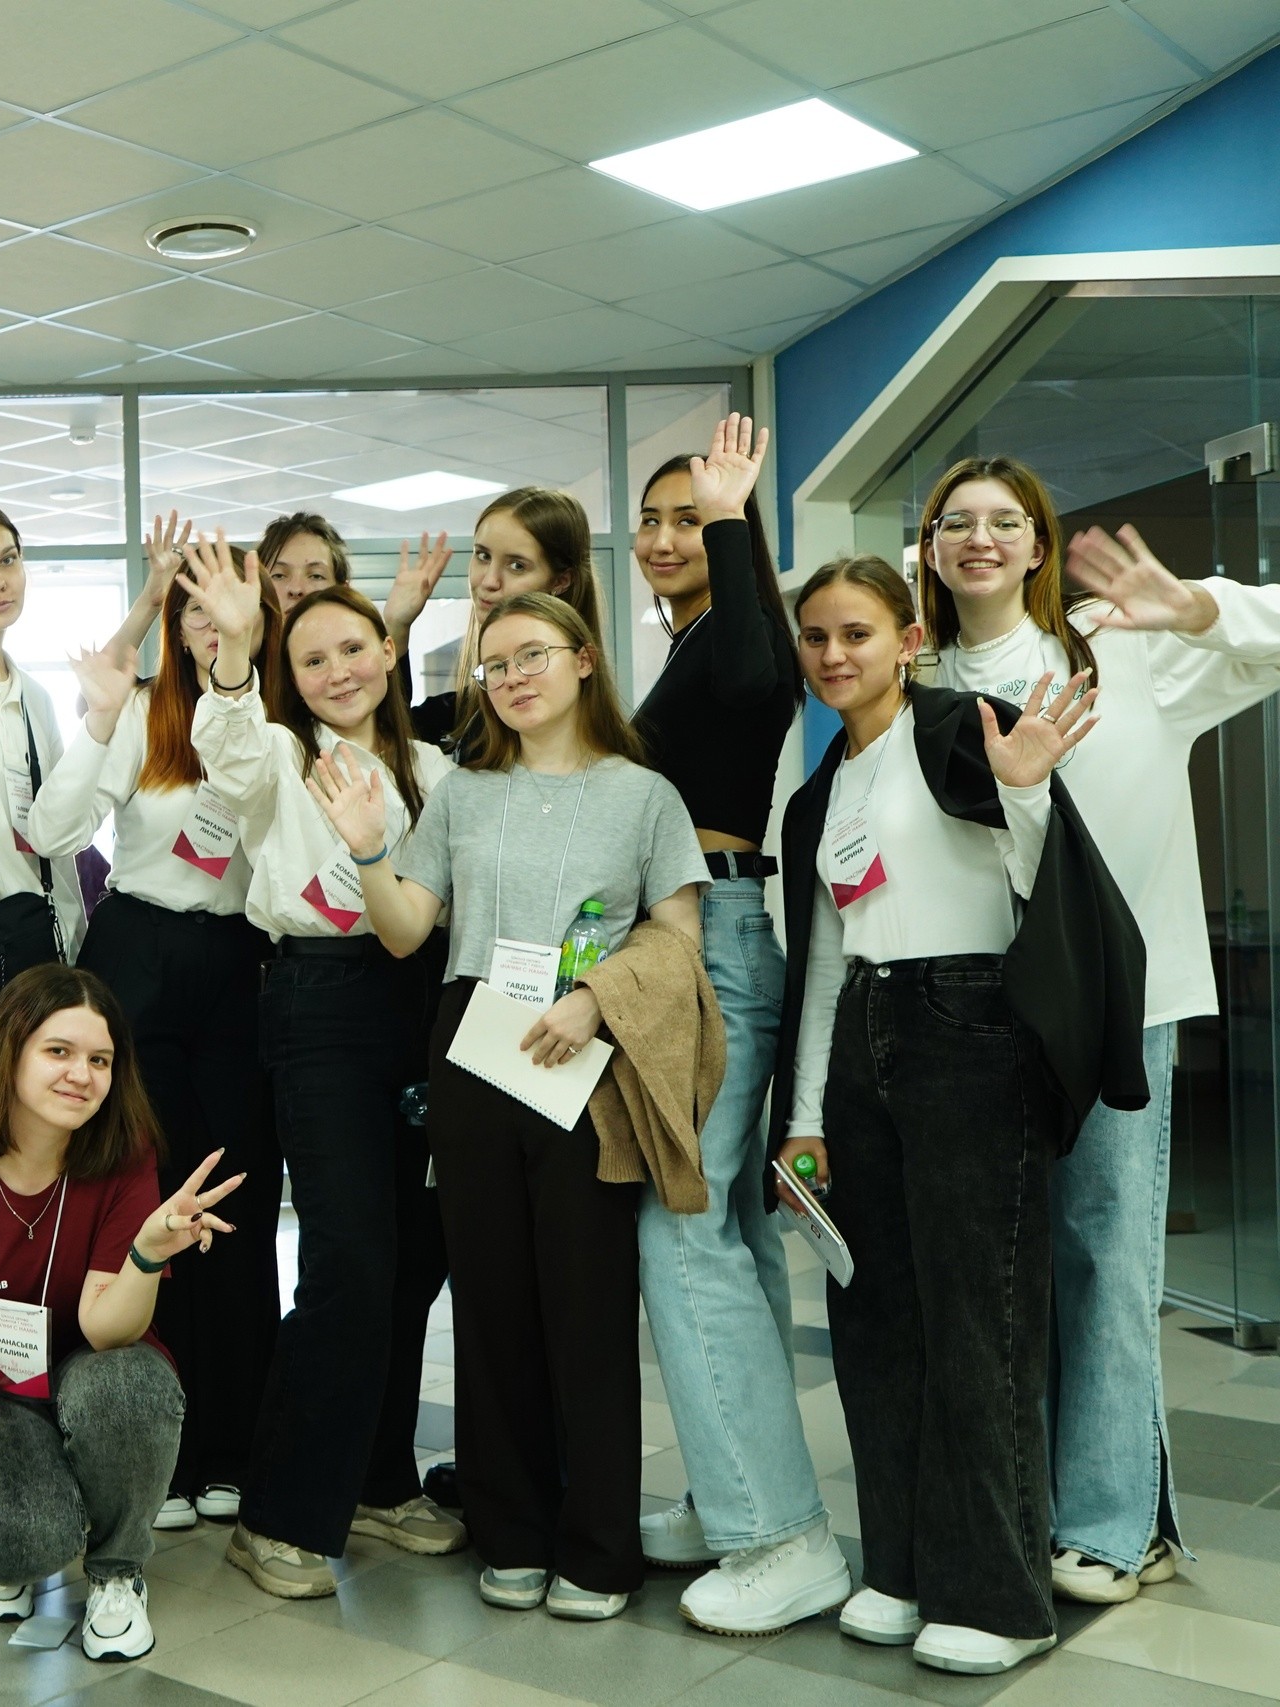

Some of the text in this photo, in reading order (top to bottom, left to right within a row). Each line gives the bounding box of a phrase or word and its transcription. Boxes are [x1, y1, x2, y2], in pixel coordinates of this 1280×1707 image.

[996, 679, 1026, 697] my
[194, 813, 233, 839] МИФТАХОВА
[199, 826, 222, 842] ЛИЛИЯ
[834, 834, 868, 859] МИНШИНА
[839, 846, 865, 866] КАРИНА
[335, 862, 362, 887] КОМАРО
[329, 869, 364, 900] АНЖЕЛИНА
[505, 981, 539, 992] ГАВДУШ
[503, 991, 545, 1003] АСТАСИЯ
[0, 1347, 30, 1359] ГАЛИНА
